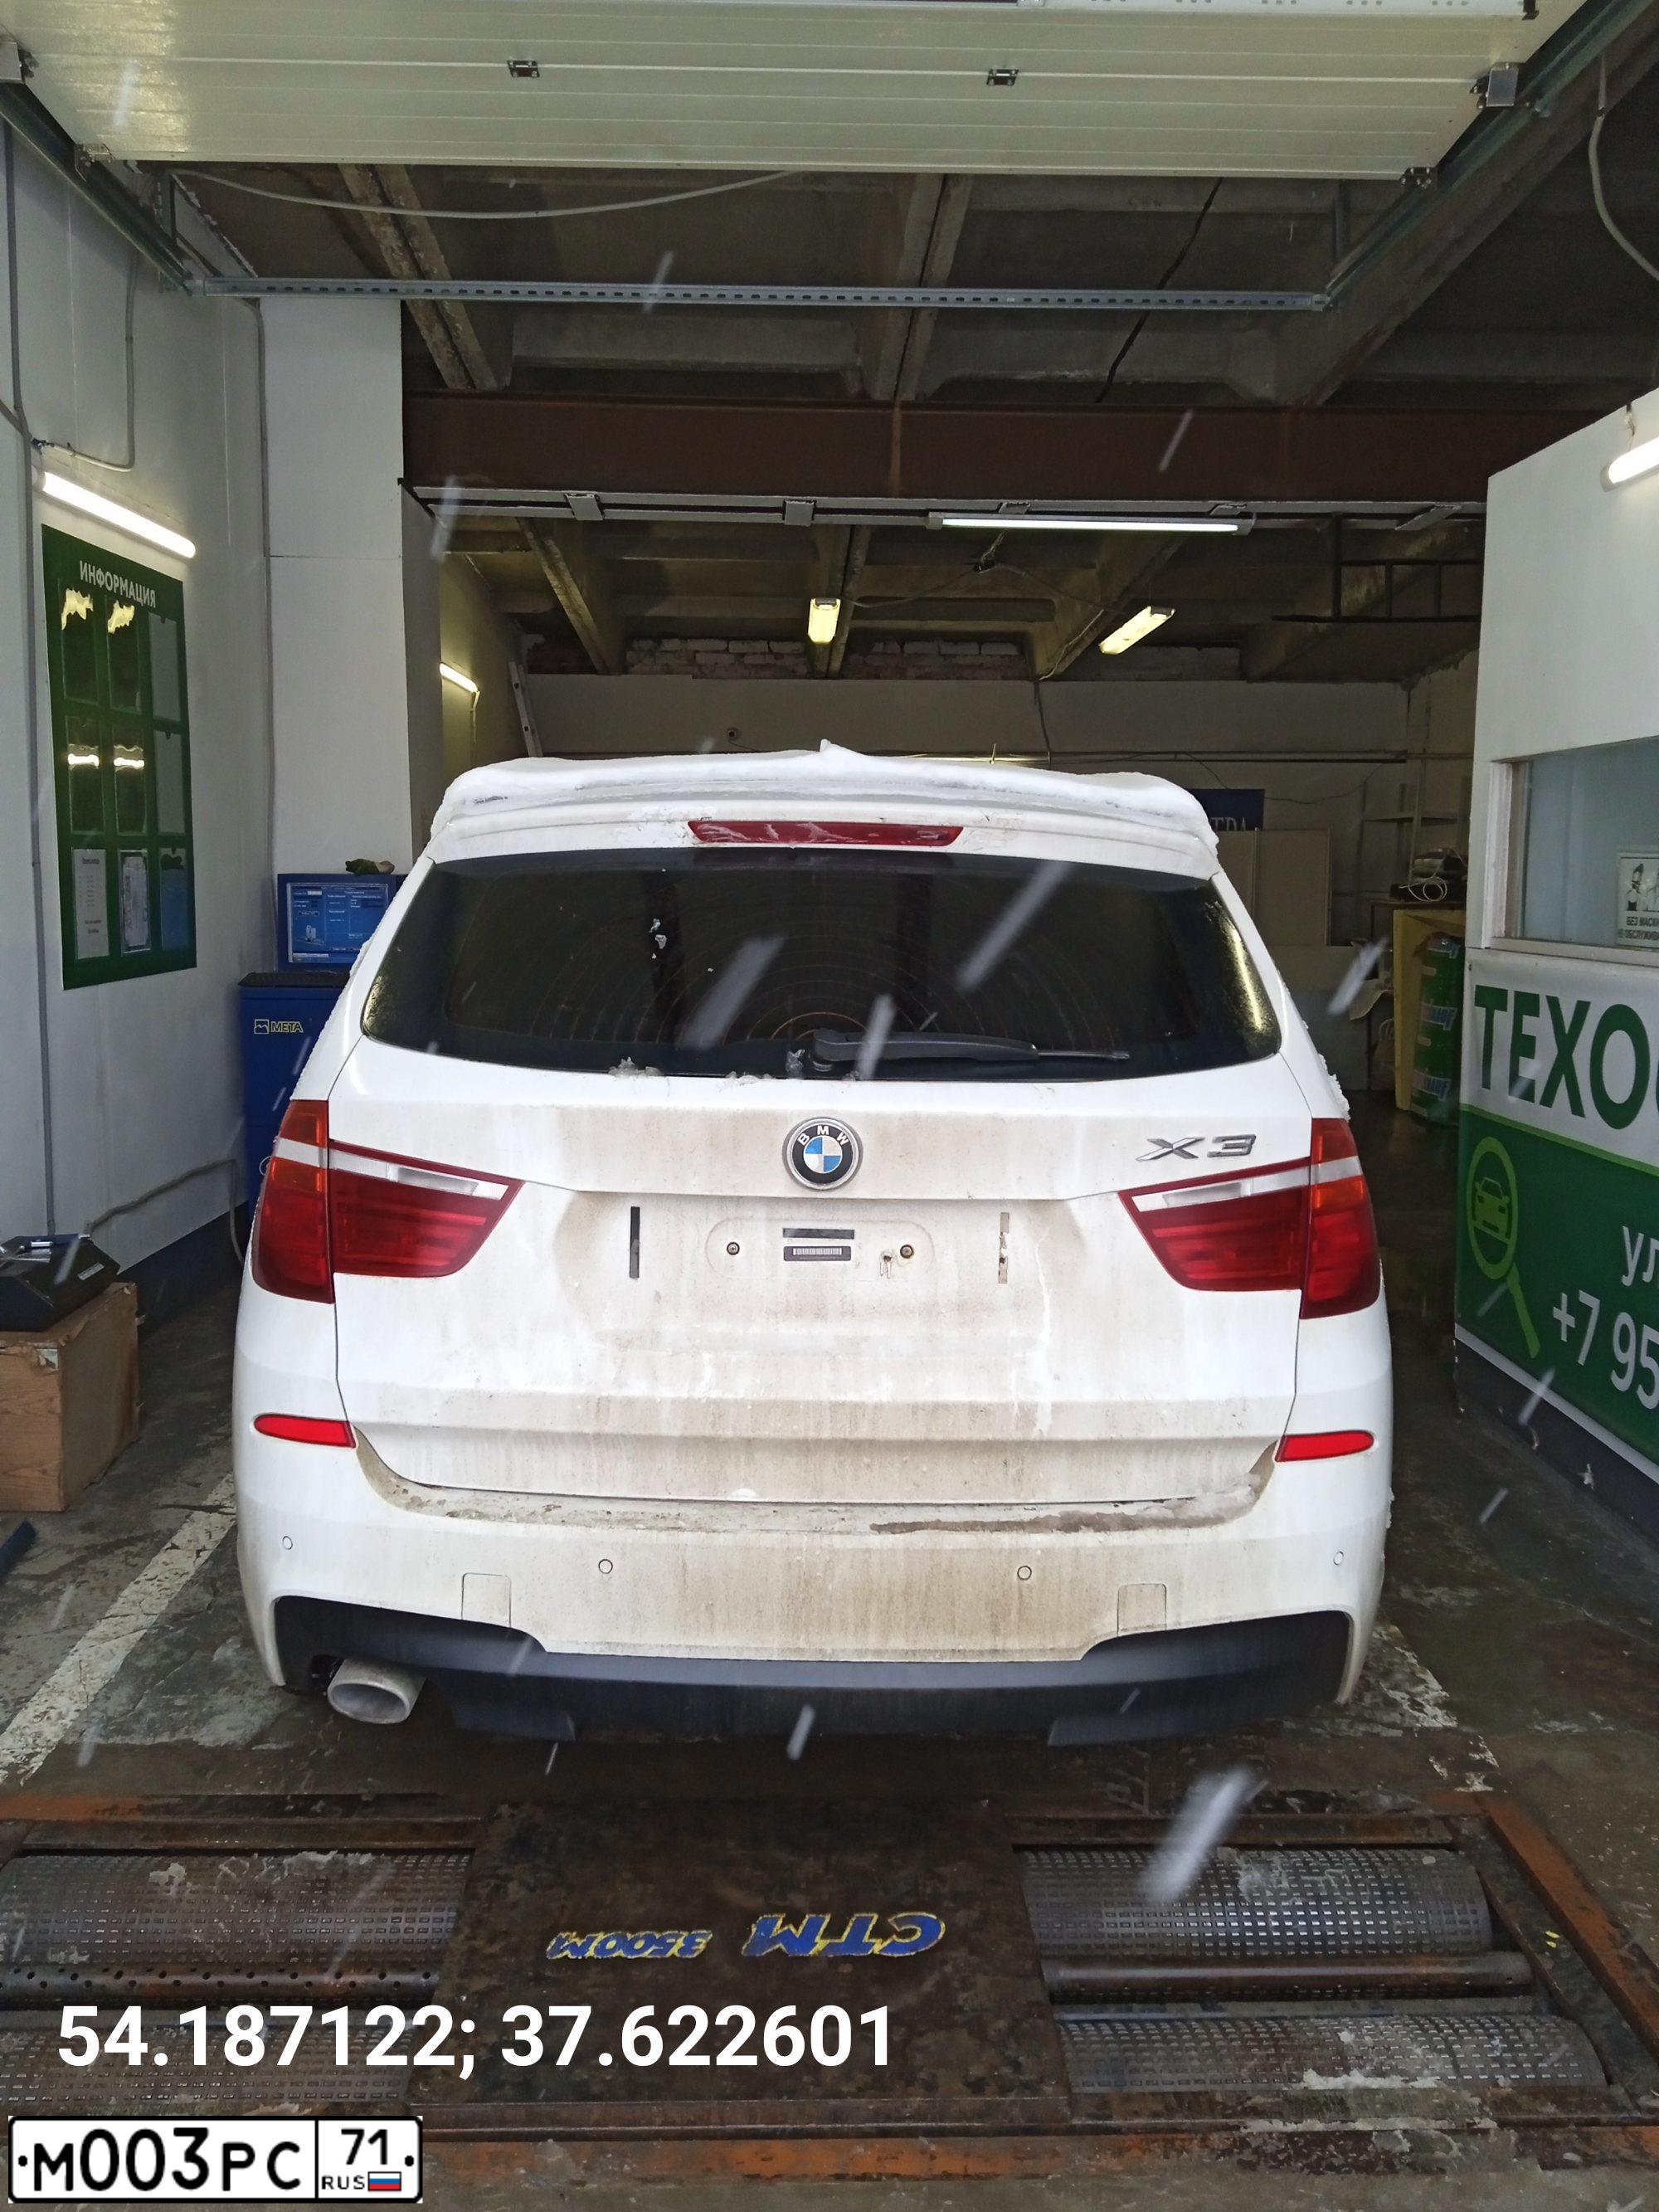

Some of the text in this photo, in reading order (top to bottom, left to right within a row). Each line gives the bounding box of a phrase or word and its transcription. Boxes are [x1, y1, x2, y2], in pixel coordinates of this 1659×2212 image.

[80, 560, 156, 608] ИНФОРМАЦИЯ
[1474, 984, 1659, 1130] ТЕХО
[797, 1125, 849, 1146] BMW
[1136, 1134, 1257, 1162] X3
[1553, 1289, 1659, 1410] +7 95
